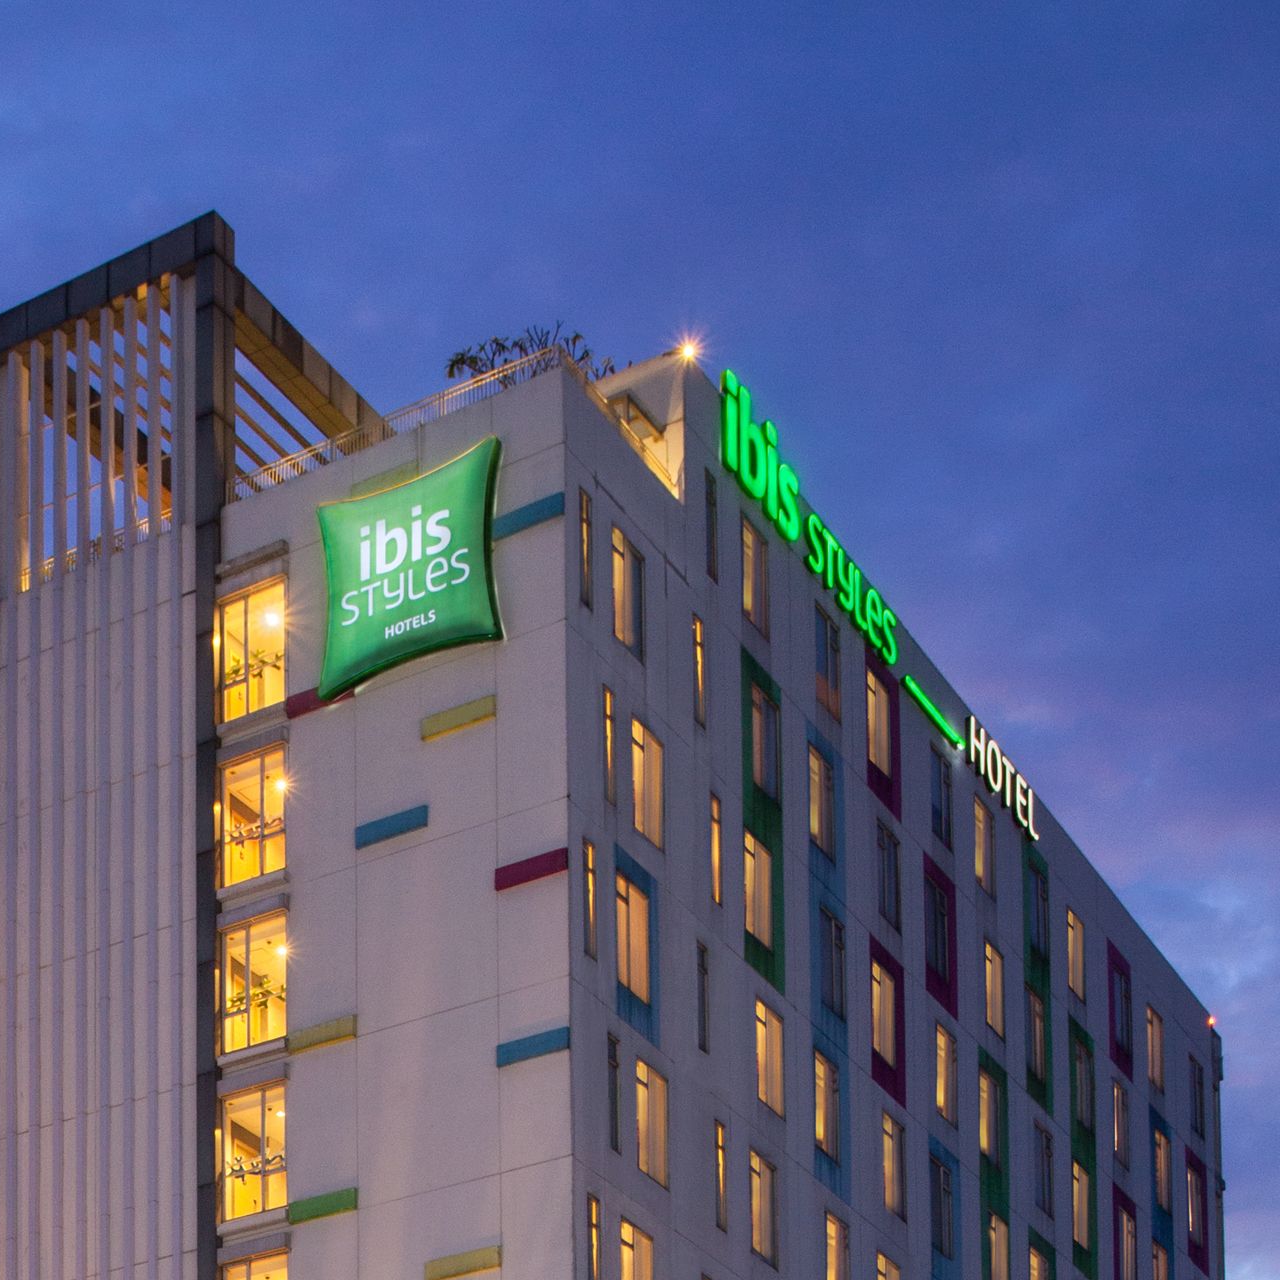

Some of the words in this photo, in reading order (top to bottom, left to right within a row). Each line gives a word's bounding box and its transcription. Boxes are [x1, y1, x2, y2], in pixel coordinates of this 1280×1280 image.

[359, 504, 452, 583] ibis
[384, 609, 437, 640] HOTELS
[721, 368, 800, 542] ibis
[968, 714, 1040, 841] HOTEL
